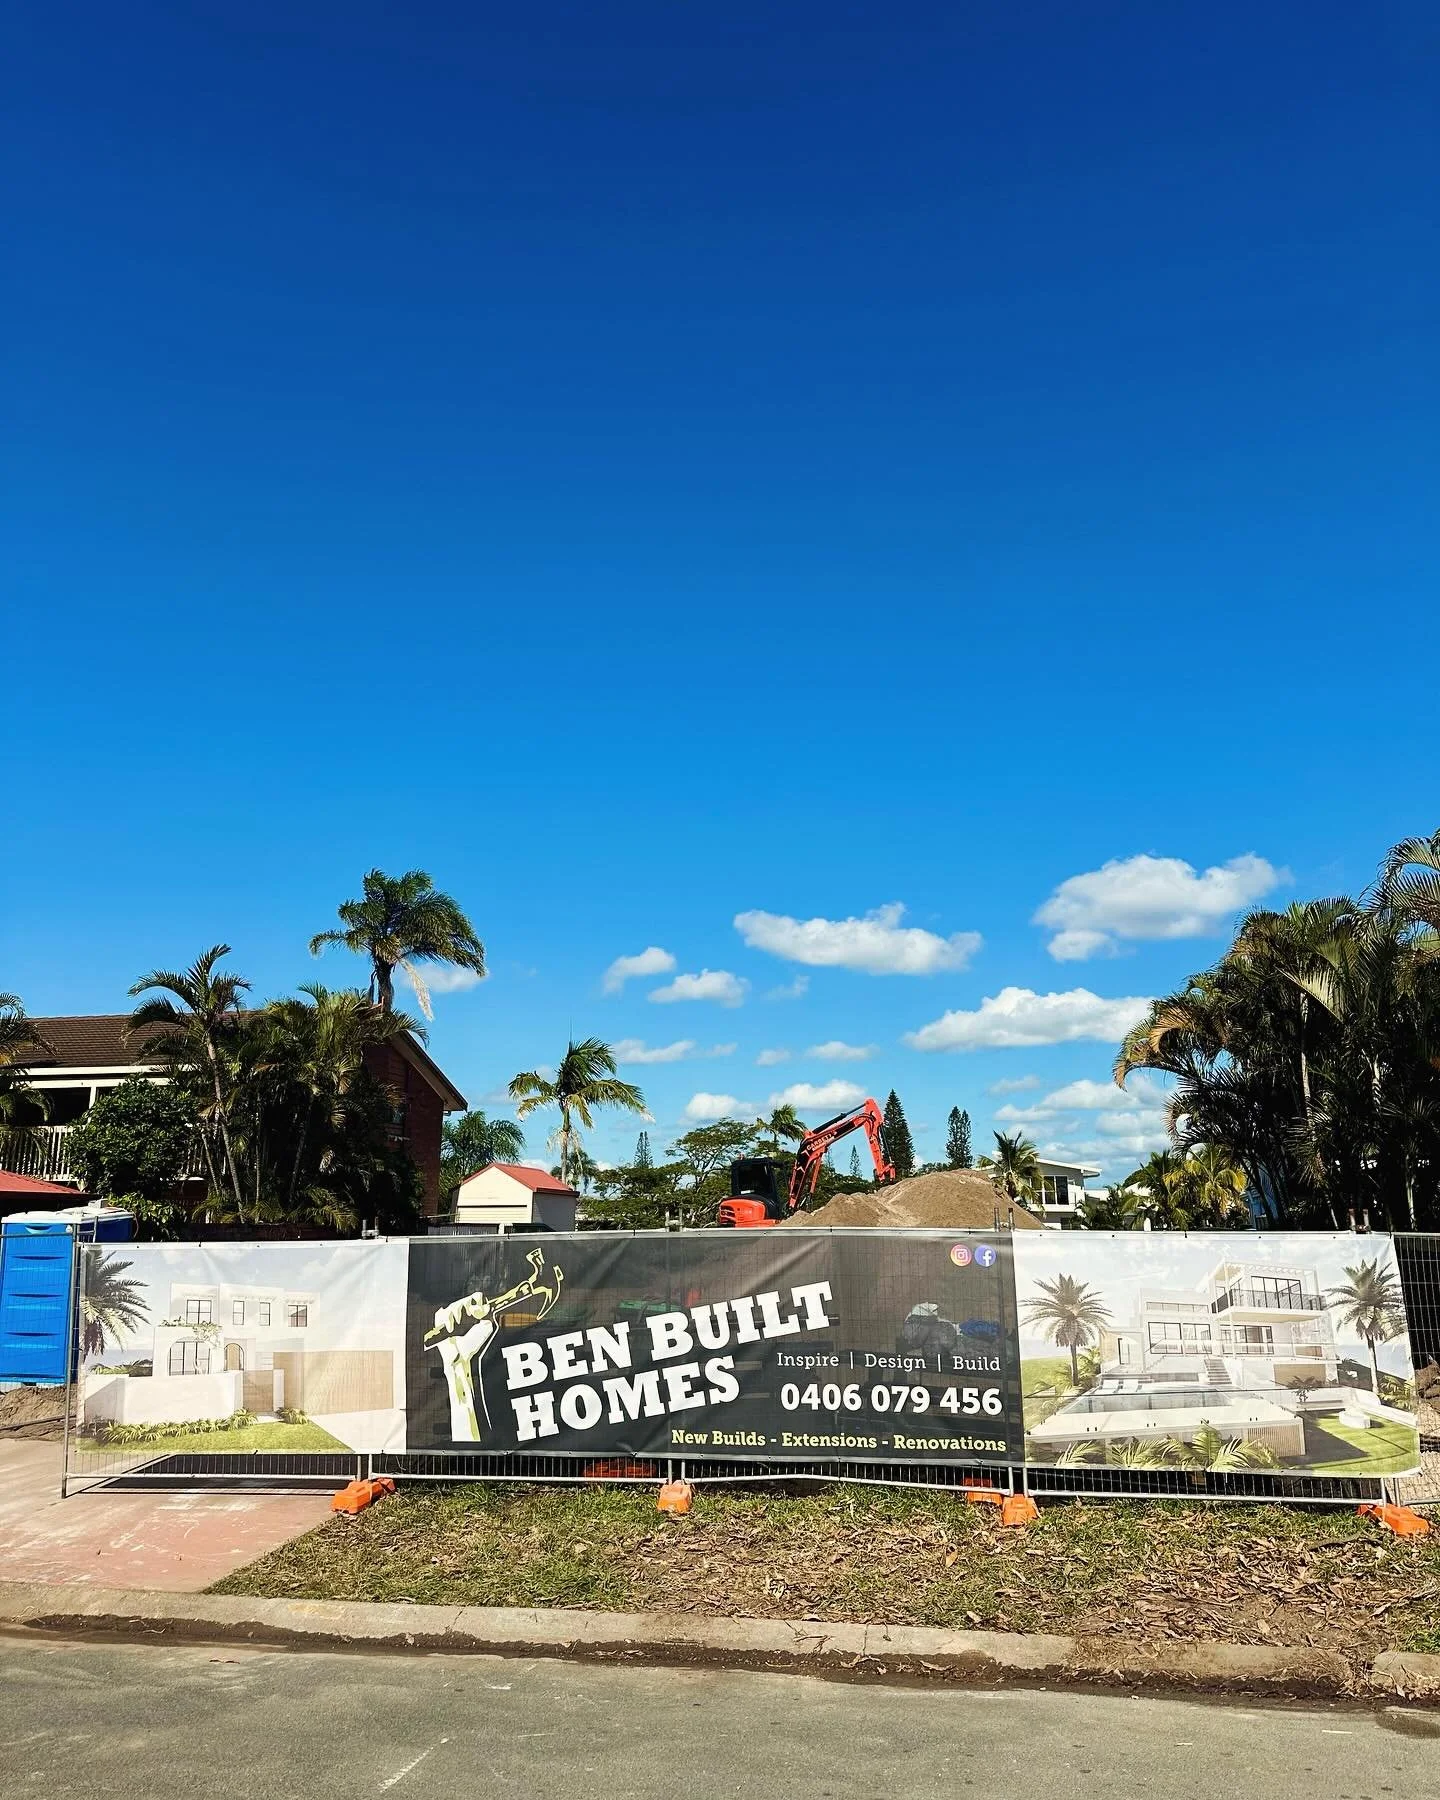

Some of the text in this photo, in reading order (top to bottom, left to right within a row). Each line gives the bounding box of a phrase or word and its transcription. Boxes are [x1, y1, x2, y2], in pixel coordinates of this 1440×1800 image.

[501, 1281, 833, 1391] BEN BUILT
[776, 1352, 839, 1369] Inspire
[864, 1354, 926, 1371] Design
[952, 1356, 1000, 1371] Build
[510, 1355, 740, 1442] HOMES
[780, 1383, 1003, 1415] 0406 079 456
[671, 1430, 708, 1445] New
[711, 1430, 766, 1447] Builds
[781, 1432, 877, 1449] Extensions
[893, 1434, 1006, 1452] Renovations
